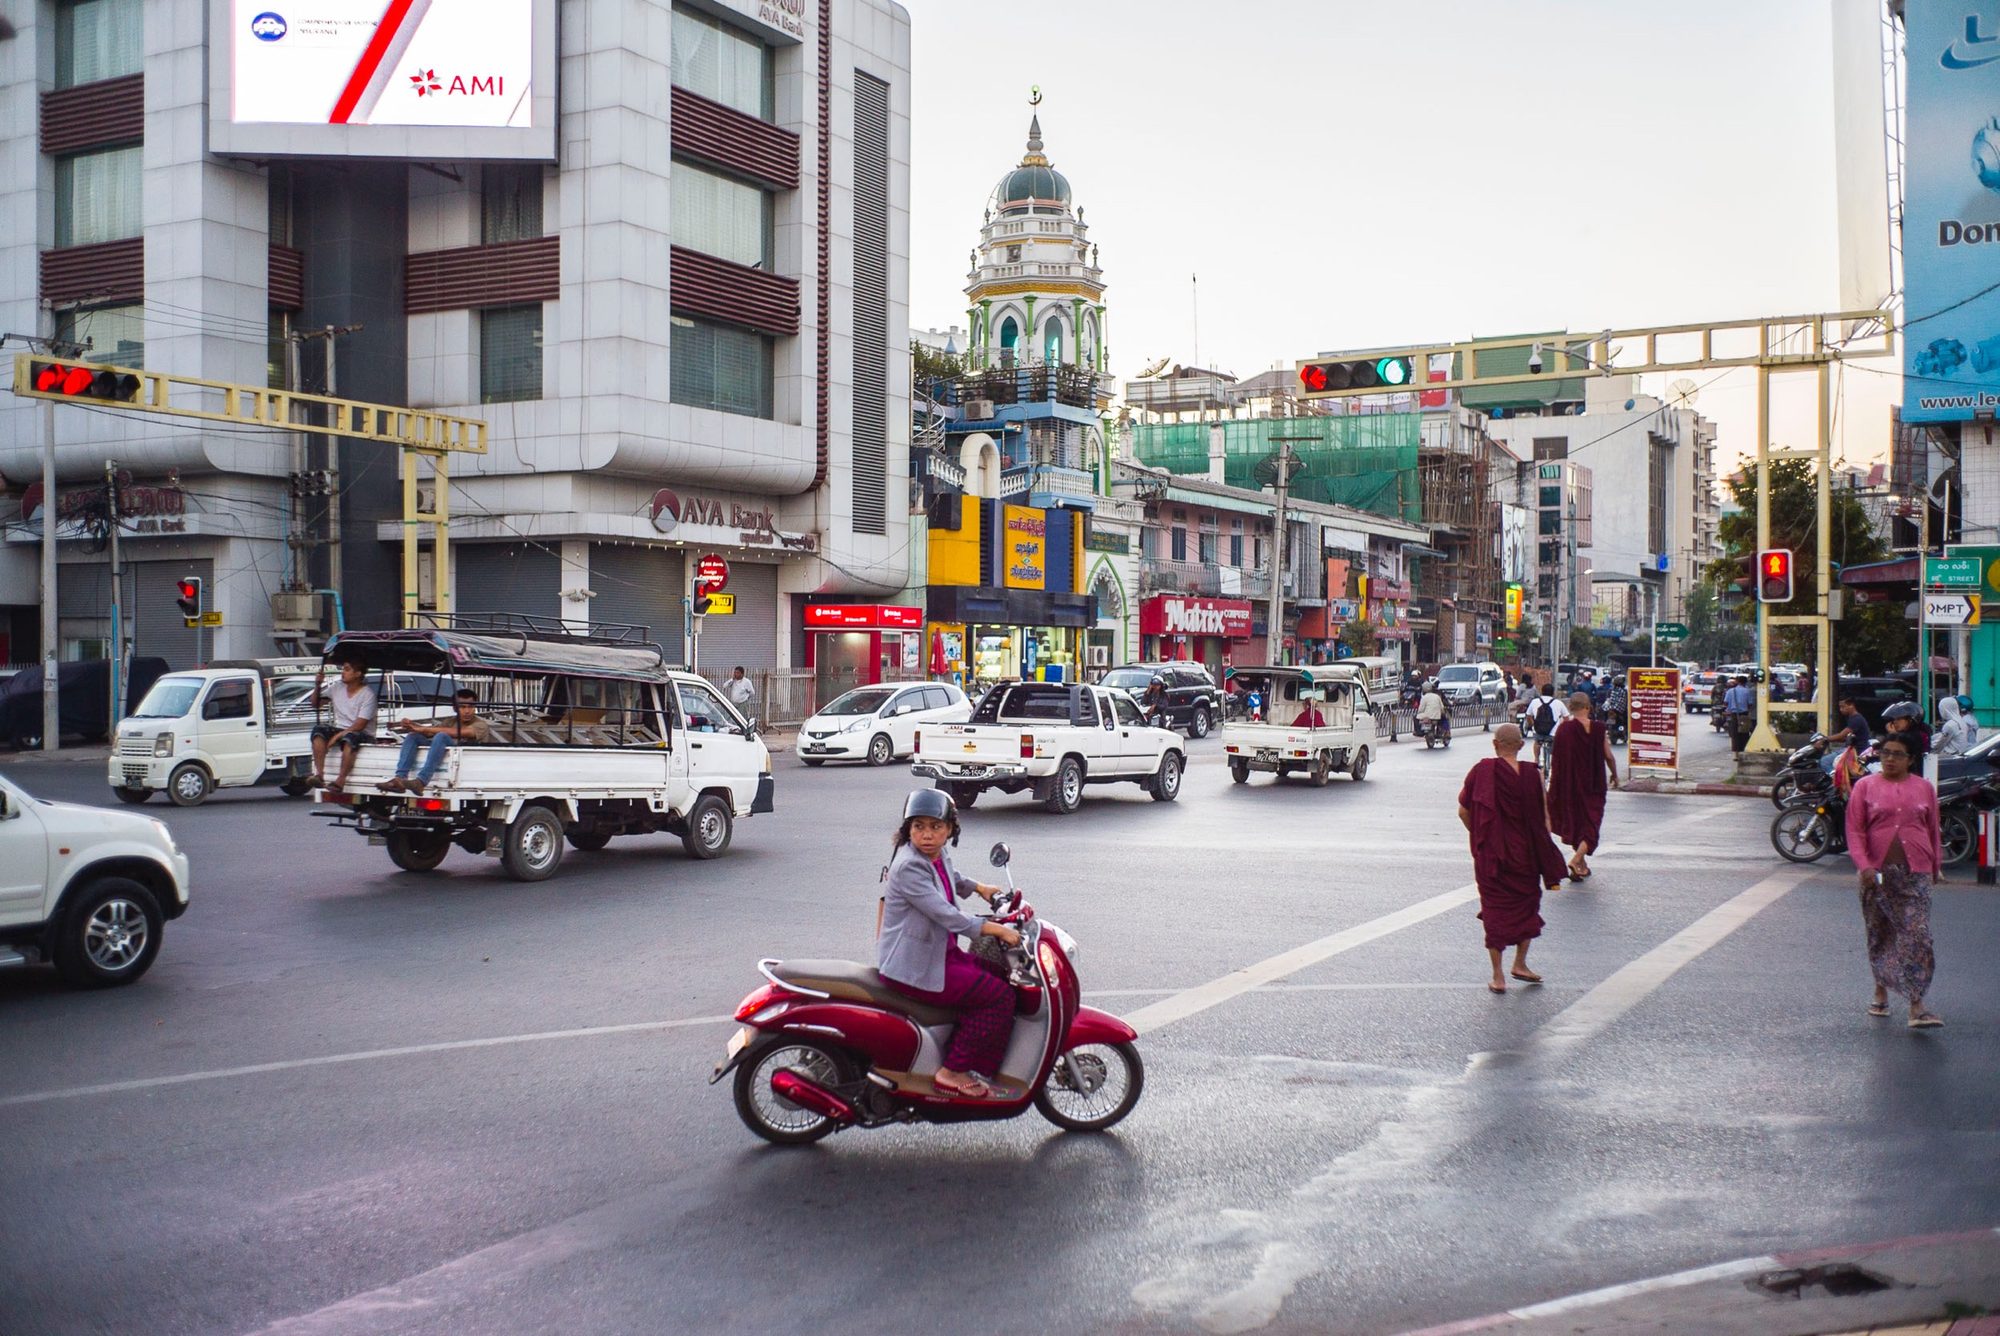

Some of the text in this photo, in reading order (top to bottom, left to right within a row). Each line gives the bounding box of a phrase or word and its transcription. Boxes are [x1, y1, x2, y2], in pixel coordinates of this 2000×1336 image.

[759, 4, 780, 26] AYA
[782, 15, 804, 37] Bank
[448, 74, 503, 96] AMI
[682, 497, 774, 531] AYA Bank
[136, 519, 159, 532] AYA
[1165, 599, 1226, 633] Matrix
[1223, 608, 1249, 619] COMPUTER
[1936, 604, 1964, 614] MPT
[273, 665, 301, 675] STEEL
